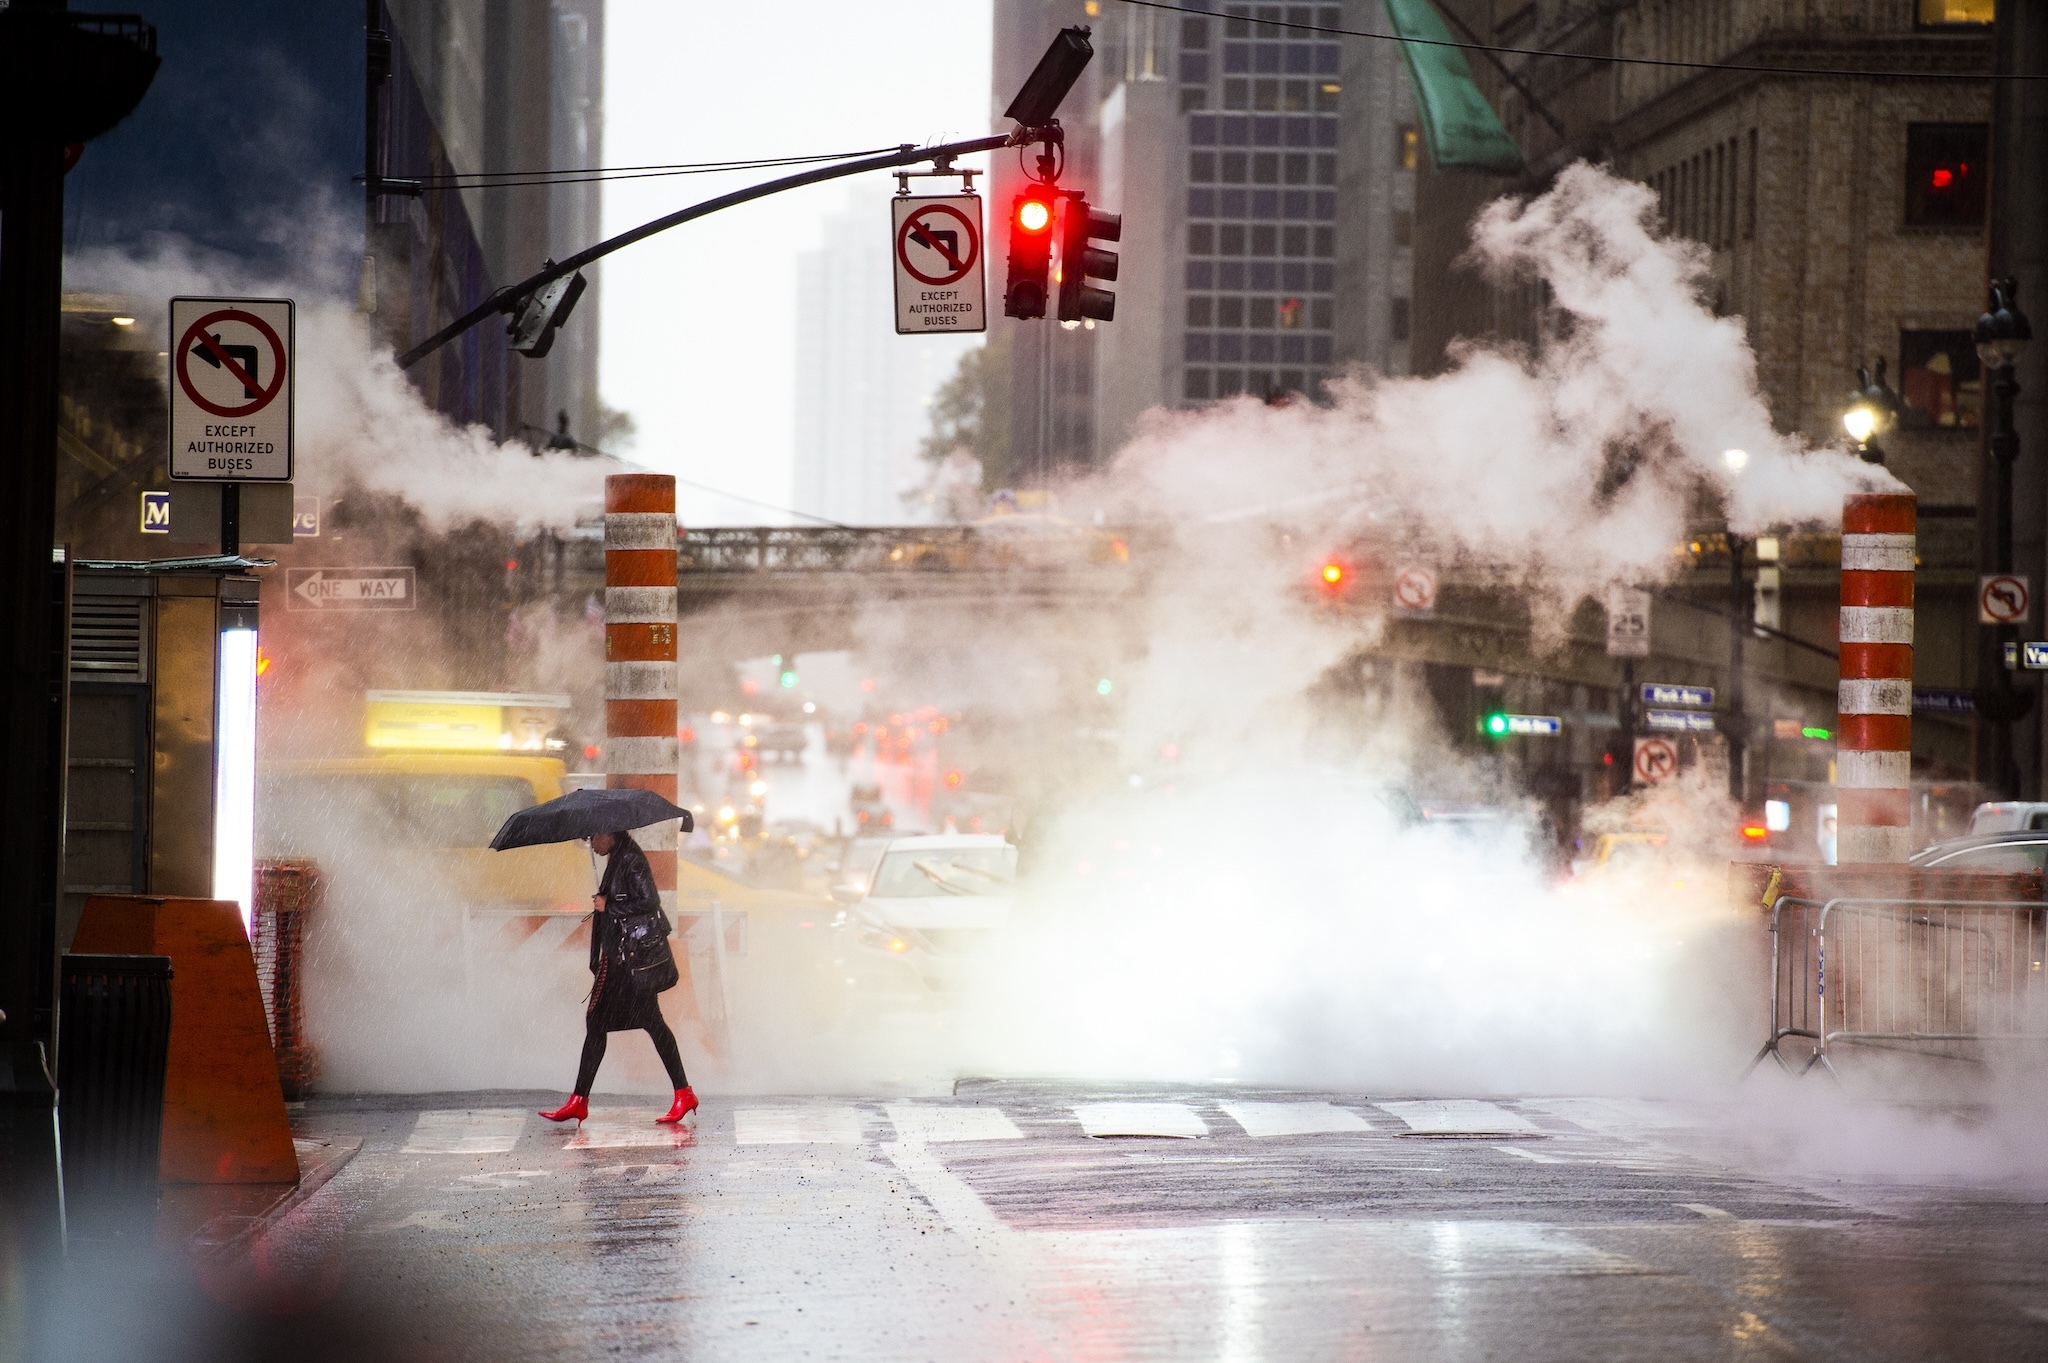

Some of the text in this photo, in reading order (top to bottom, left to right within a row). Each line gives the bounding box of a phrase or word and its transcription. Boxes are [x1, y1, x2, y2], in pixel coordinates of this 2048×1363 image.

[921, 291, 959, 301] EXCEPT
[908, 303, 973, 314] AUTHORIZED
[924, 316, 958, 326] BUSES
[205, 425, 256, 437] EXCEPT
[187, 441, 274, 454] AUTHORIZED
[208, 458, 253, 470] BUSES
[144, 501, 169, 525] M
[307, 581, 398, 598] ONE WAY
[1614, 613, 1644, 635] 25
[2027, 647, 2048, 665] Va
